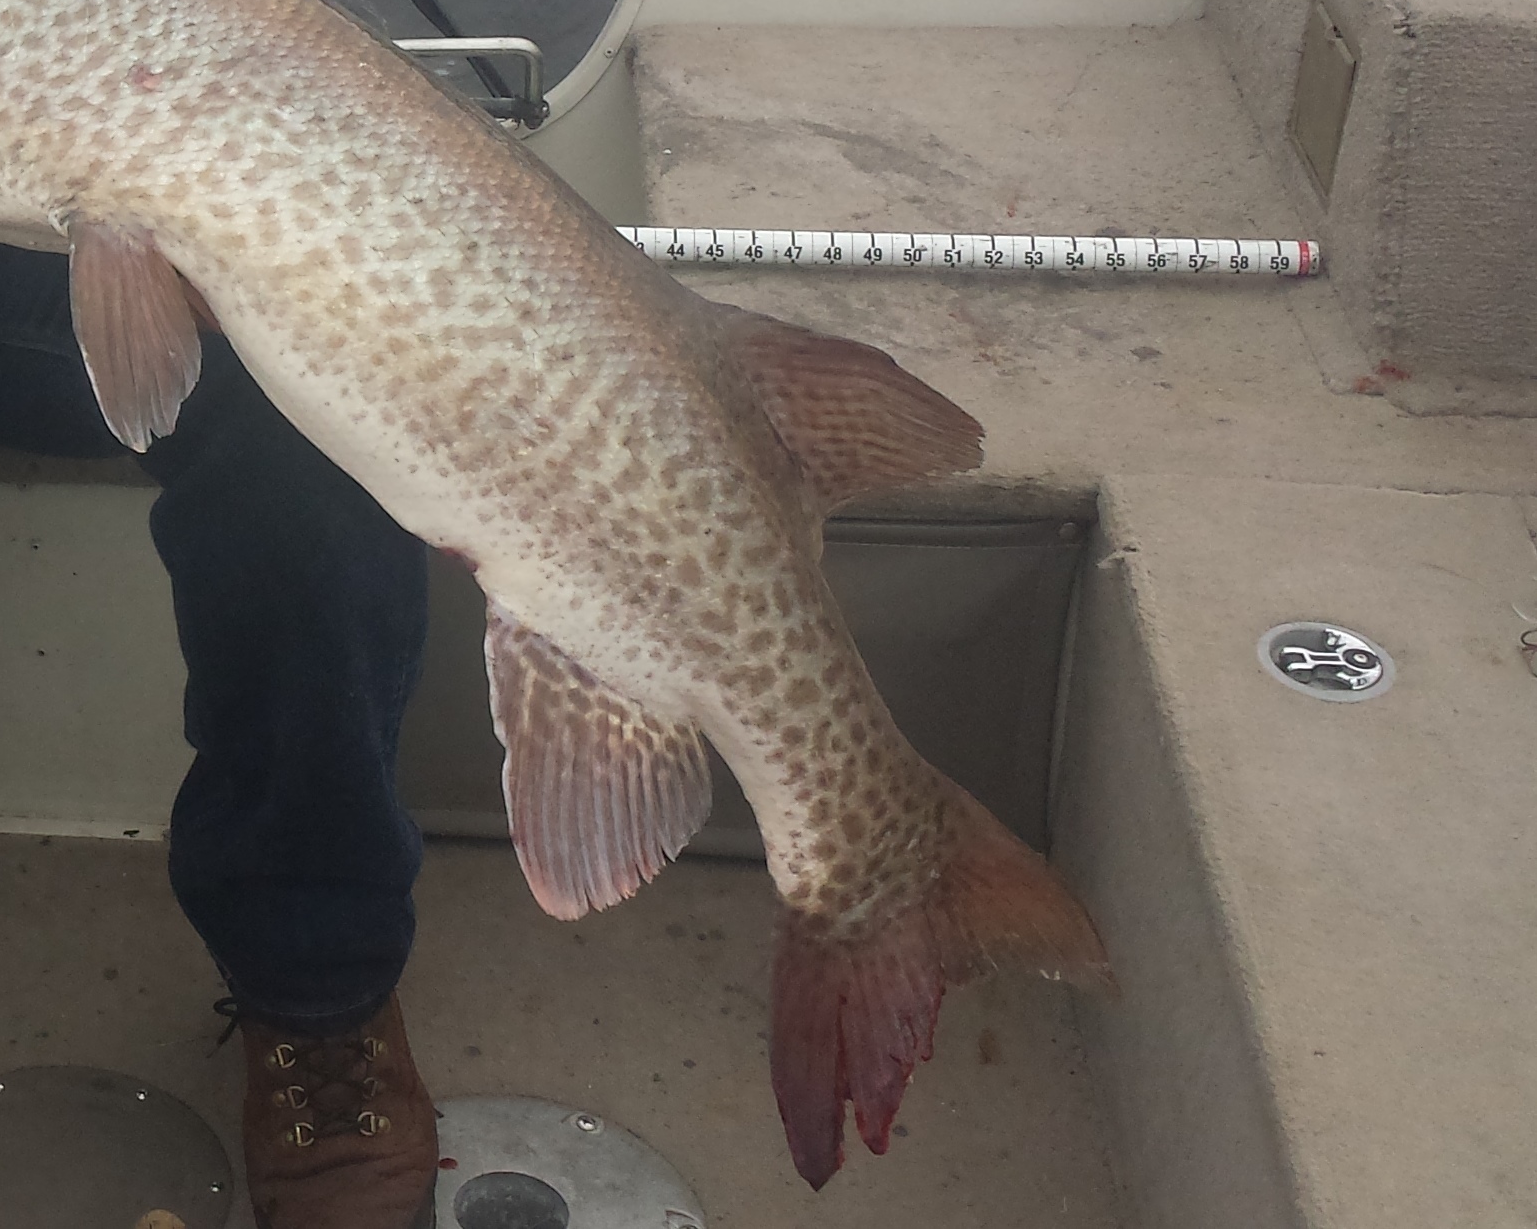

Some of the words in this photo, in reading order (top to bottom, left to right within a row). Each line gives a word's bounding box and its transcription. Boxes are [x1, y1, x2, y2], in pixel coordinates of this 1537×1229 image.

[667, 244, 684, 257] 44
[706, 244, 724, 257] 45
[745, 245, 763, 258] 46
[784, 246, 802, 259] 47
[823, 247, 842, 260] 48
[864, 248, 882, 261] 49
[903, 249, 922, 262] 50
[944, 250, 961, 263] 51
[985, 251, 1003, 264] 52
[1025, 252, 1043, 265] 53
[1066, 253, 1084, 266] 54
[1106, 253, 1125, 266] 55
[1147, 254, 1166, 267] 56
[1189, 255, 1207, 269] 57
[1230, 256, 1249, 269] 58
[1270, 256, 1289, 270] 59
